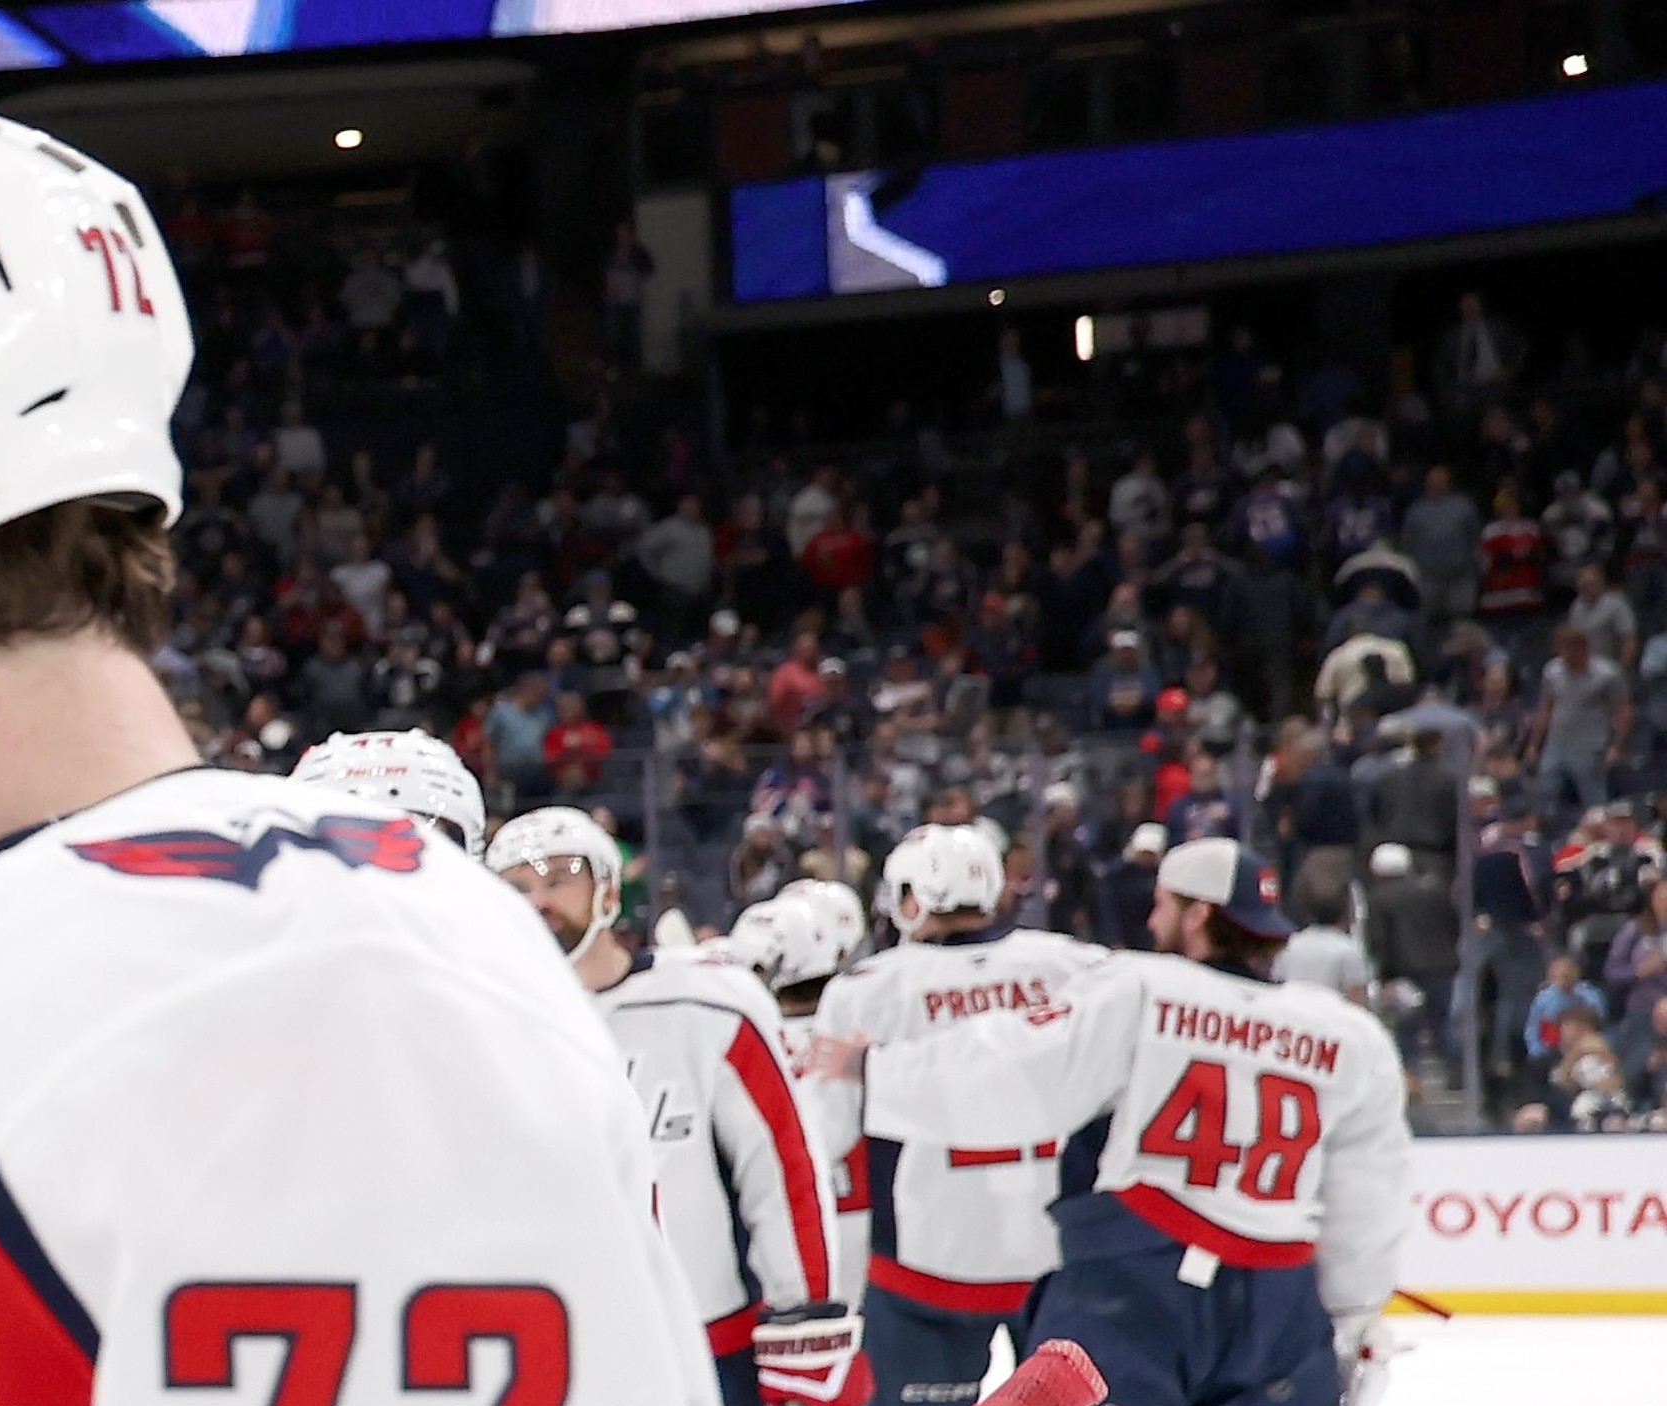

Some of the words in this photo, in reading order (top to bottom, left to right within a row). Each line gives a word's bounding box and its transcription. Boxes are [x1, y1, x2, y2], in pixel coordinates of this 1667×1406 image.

[925, 976, 1051, 1023] PROTAS
[1153, 1001, 1341, 1075] THOMPSON
[1138, 1060, 1322, 1202] 48
[1411, 1190, 1667, 1237] OYOTA
